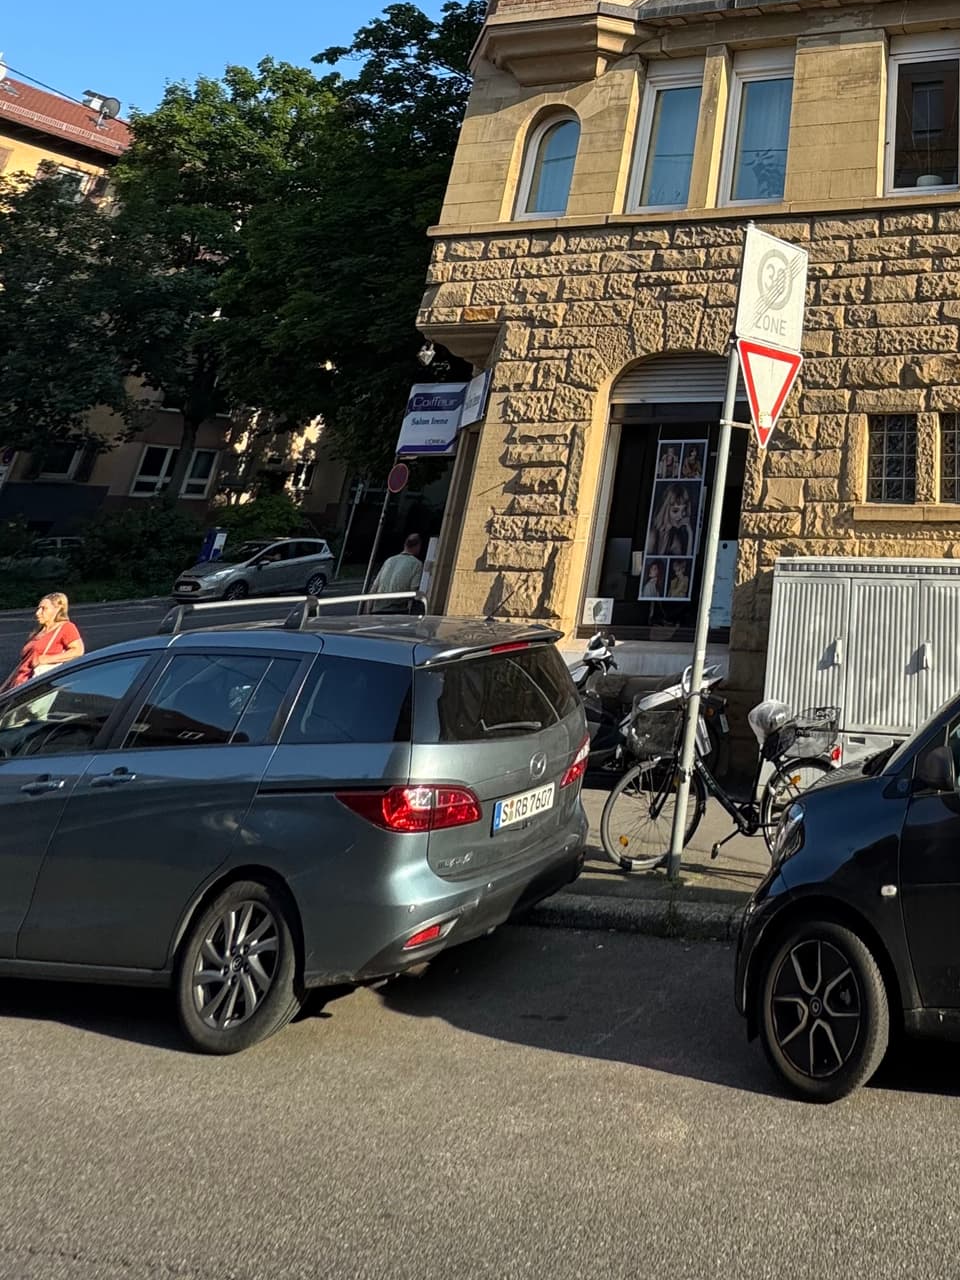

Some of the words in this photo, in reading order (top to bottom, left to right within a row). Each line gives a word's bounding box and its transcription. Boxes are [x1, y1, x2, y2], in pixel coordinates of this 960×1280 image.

[754, 311, 787, 336] ZONE
[412, 396, 457, 407] Coiffeur
[411, 416, 429, 425] Salon
